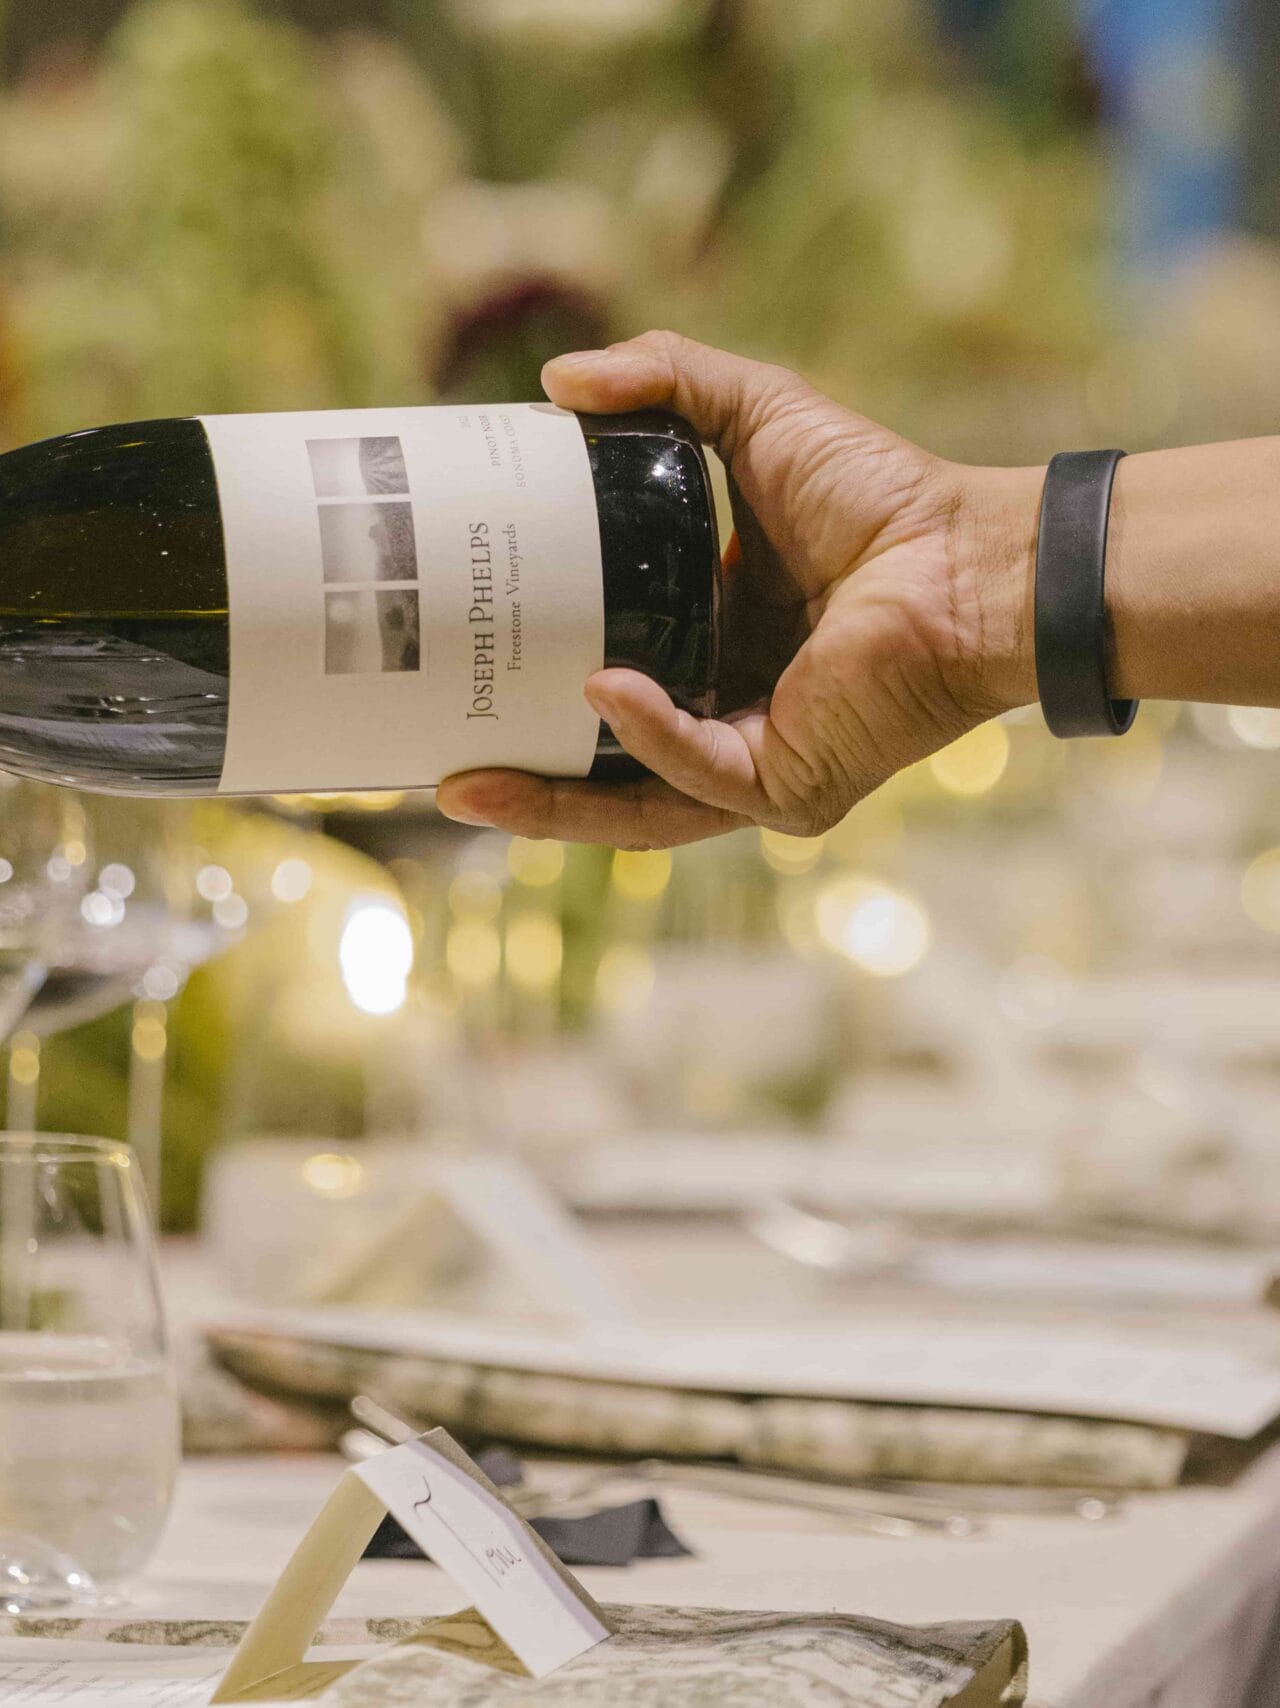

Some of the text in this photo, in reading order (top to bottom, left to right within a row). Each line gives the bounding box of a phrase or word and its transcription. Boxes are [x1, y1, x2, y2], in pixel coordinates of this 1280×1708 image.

[478, 414, 502, 467] PINOT NOIR
[509, 439, 527, 488] SONOMA
[466, 522, 499, 720] JOSEPH PHELPS
[502, 523, 524, 671] Freestone Vineyards
